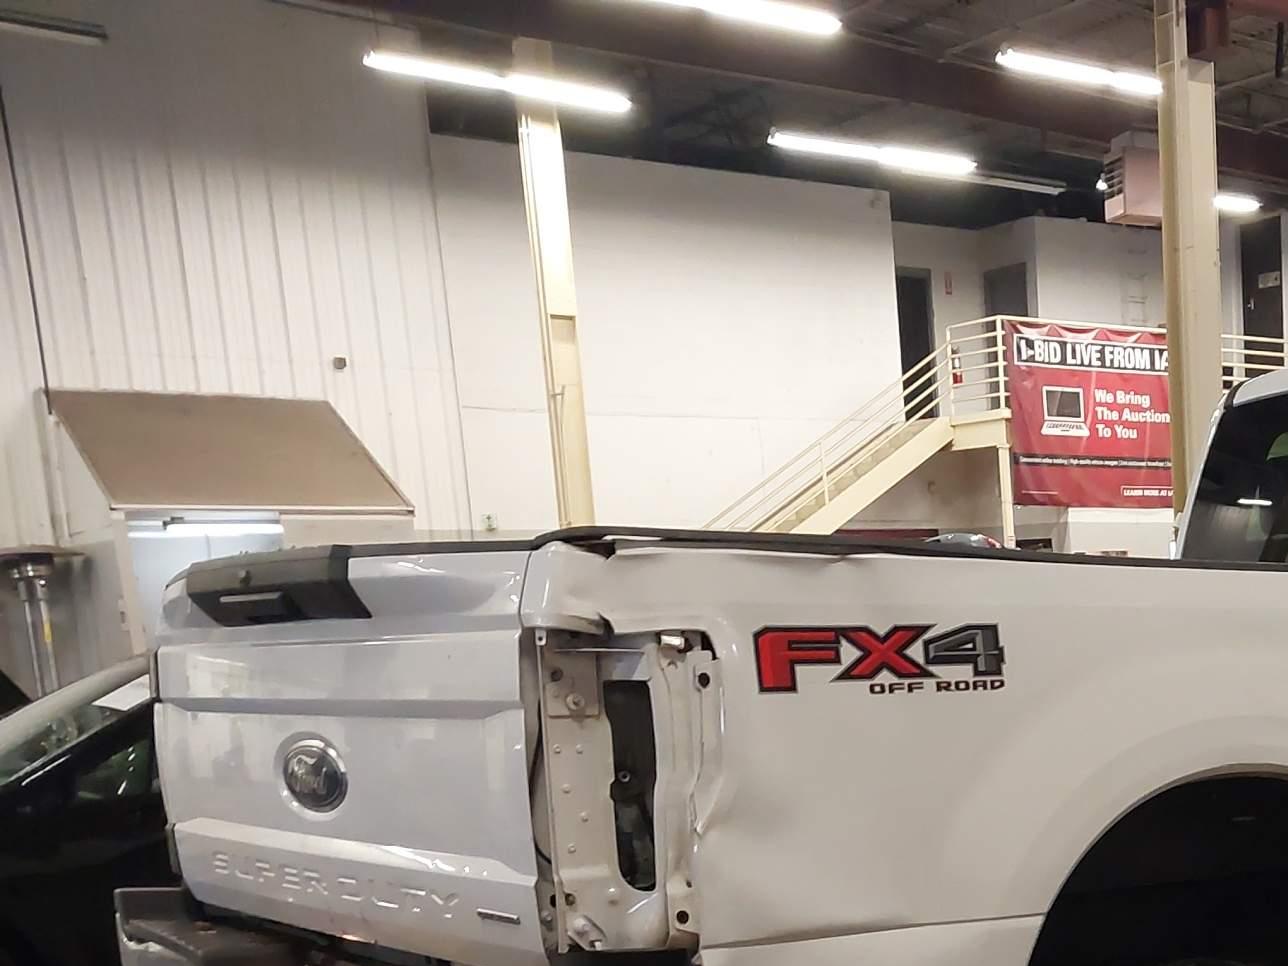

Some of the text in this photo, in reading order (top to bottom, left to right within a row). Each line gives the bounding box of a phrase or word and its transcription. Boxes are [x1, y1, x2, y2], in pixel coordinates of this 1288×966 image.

[1066, 341, 1102, 367] LIVE
[1104, 345, 1151, 370] FROM
[1094, 388, 1151, 408] We Bring
[1095, 406, 1171, 424] The Auction
[1095, 423, 1138, 439] To You
[753, 623, 1006, 694] FX4
[869, 678, 1006, 696] OFF ROAD
[212, 853, 328, 895] SUPER
[336, 876, 459, 918] DUTY
